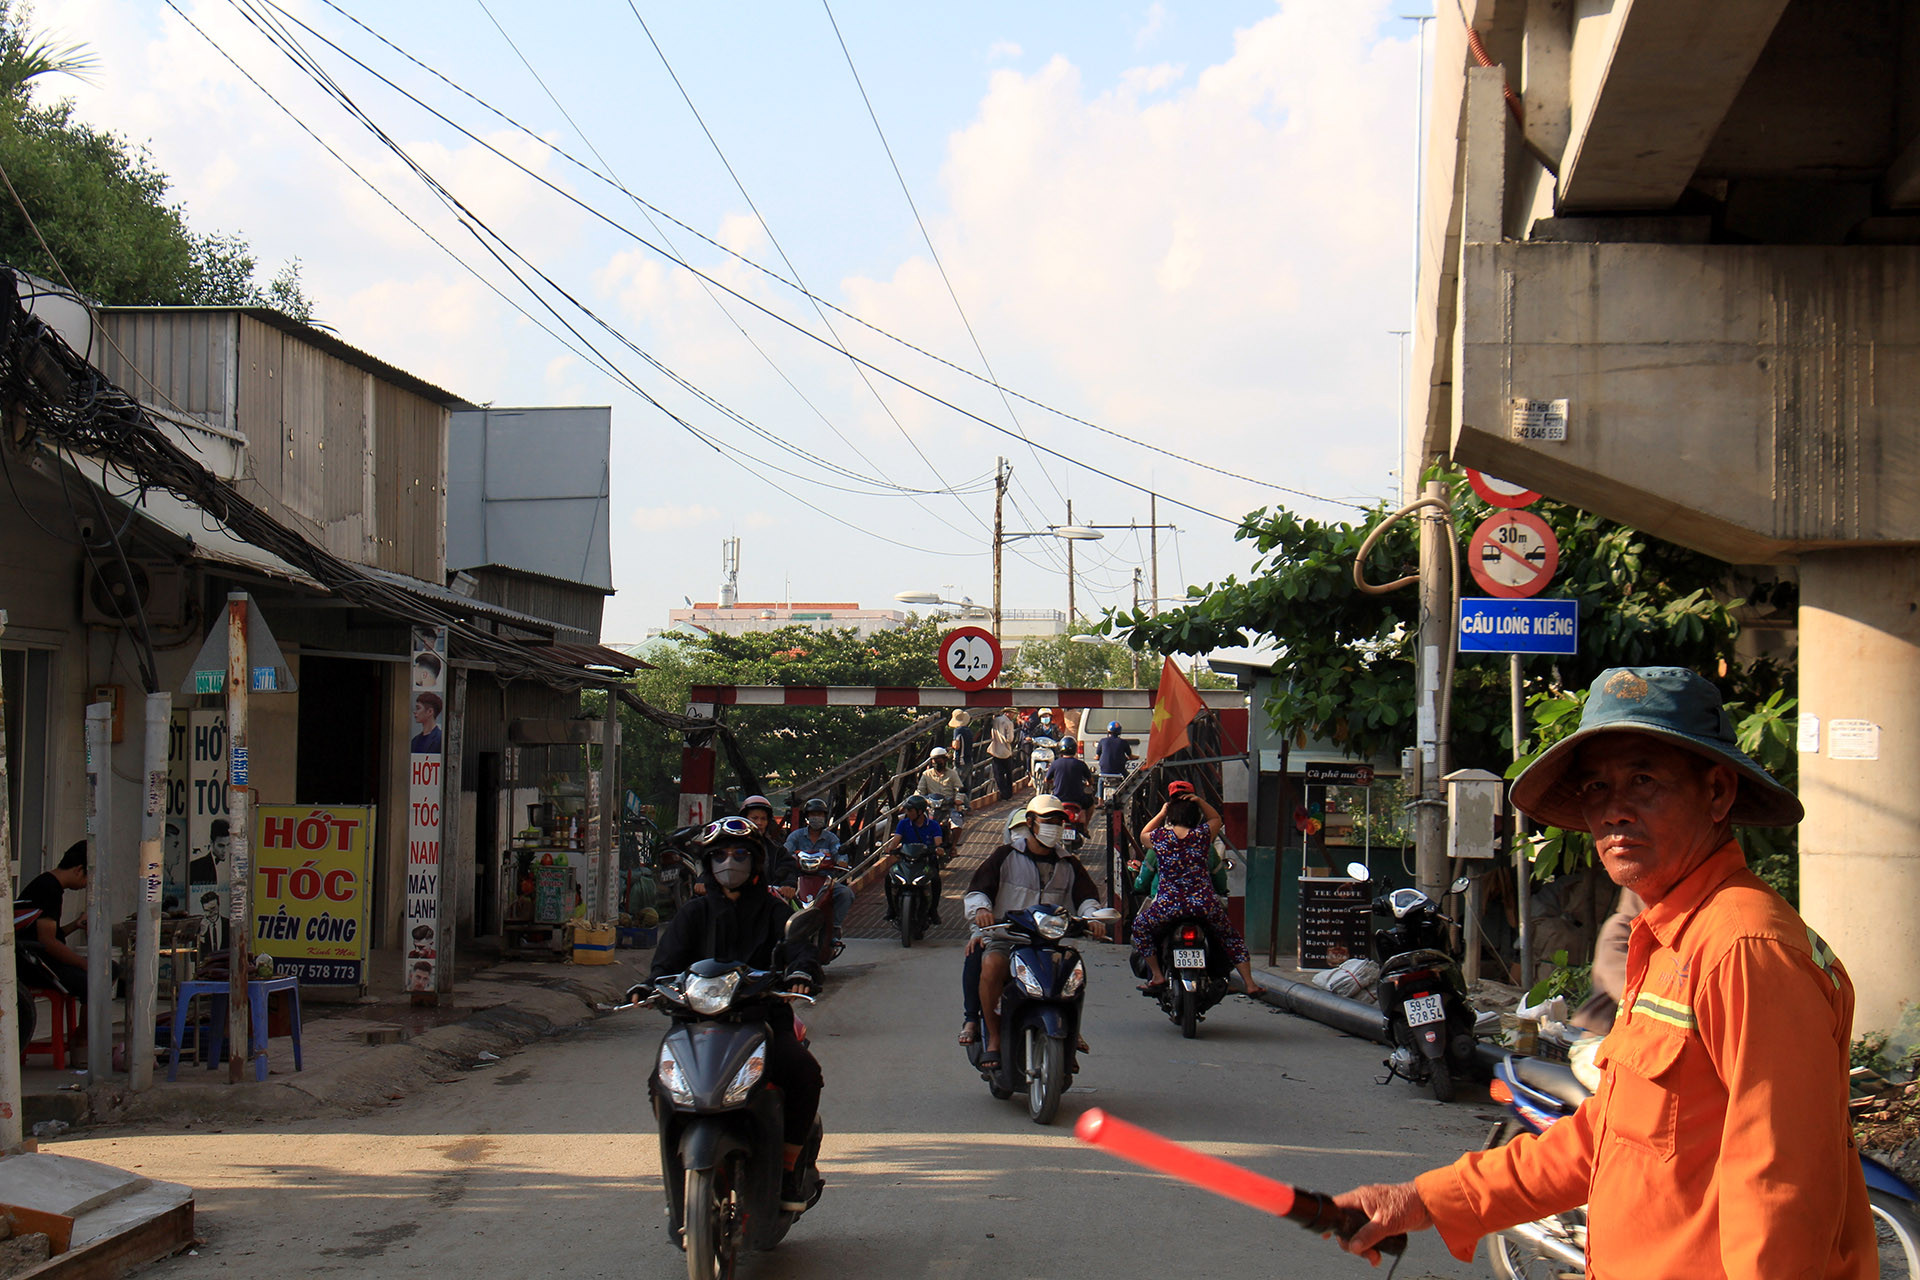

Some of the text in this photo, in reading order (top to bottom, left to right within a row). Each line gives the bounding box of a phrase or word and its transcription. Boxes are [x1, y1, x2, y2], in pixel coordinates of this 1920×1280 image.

[1461, 610, 1573, 635] CẦU LONG KIỂNG
[412, 756, 440, 786] HỚT
[412, 797, 439, 827] TÓC
[263, 810, 361, 851] HỚT
[410, 841, 439, 865] NAM
[258, 860, 356, 902] TÓC
[408, 869, 437, 894] MÁY
[257, 904, 301, 940] TIẾN
[408, 898, 436, 924] LẠNH
[306, 911, 357, 943] CÔNG
[276, 963, 356, 979] 0797 578 773
[1410, 997, 1437, 1012] 59-G2
